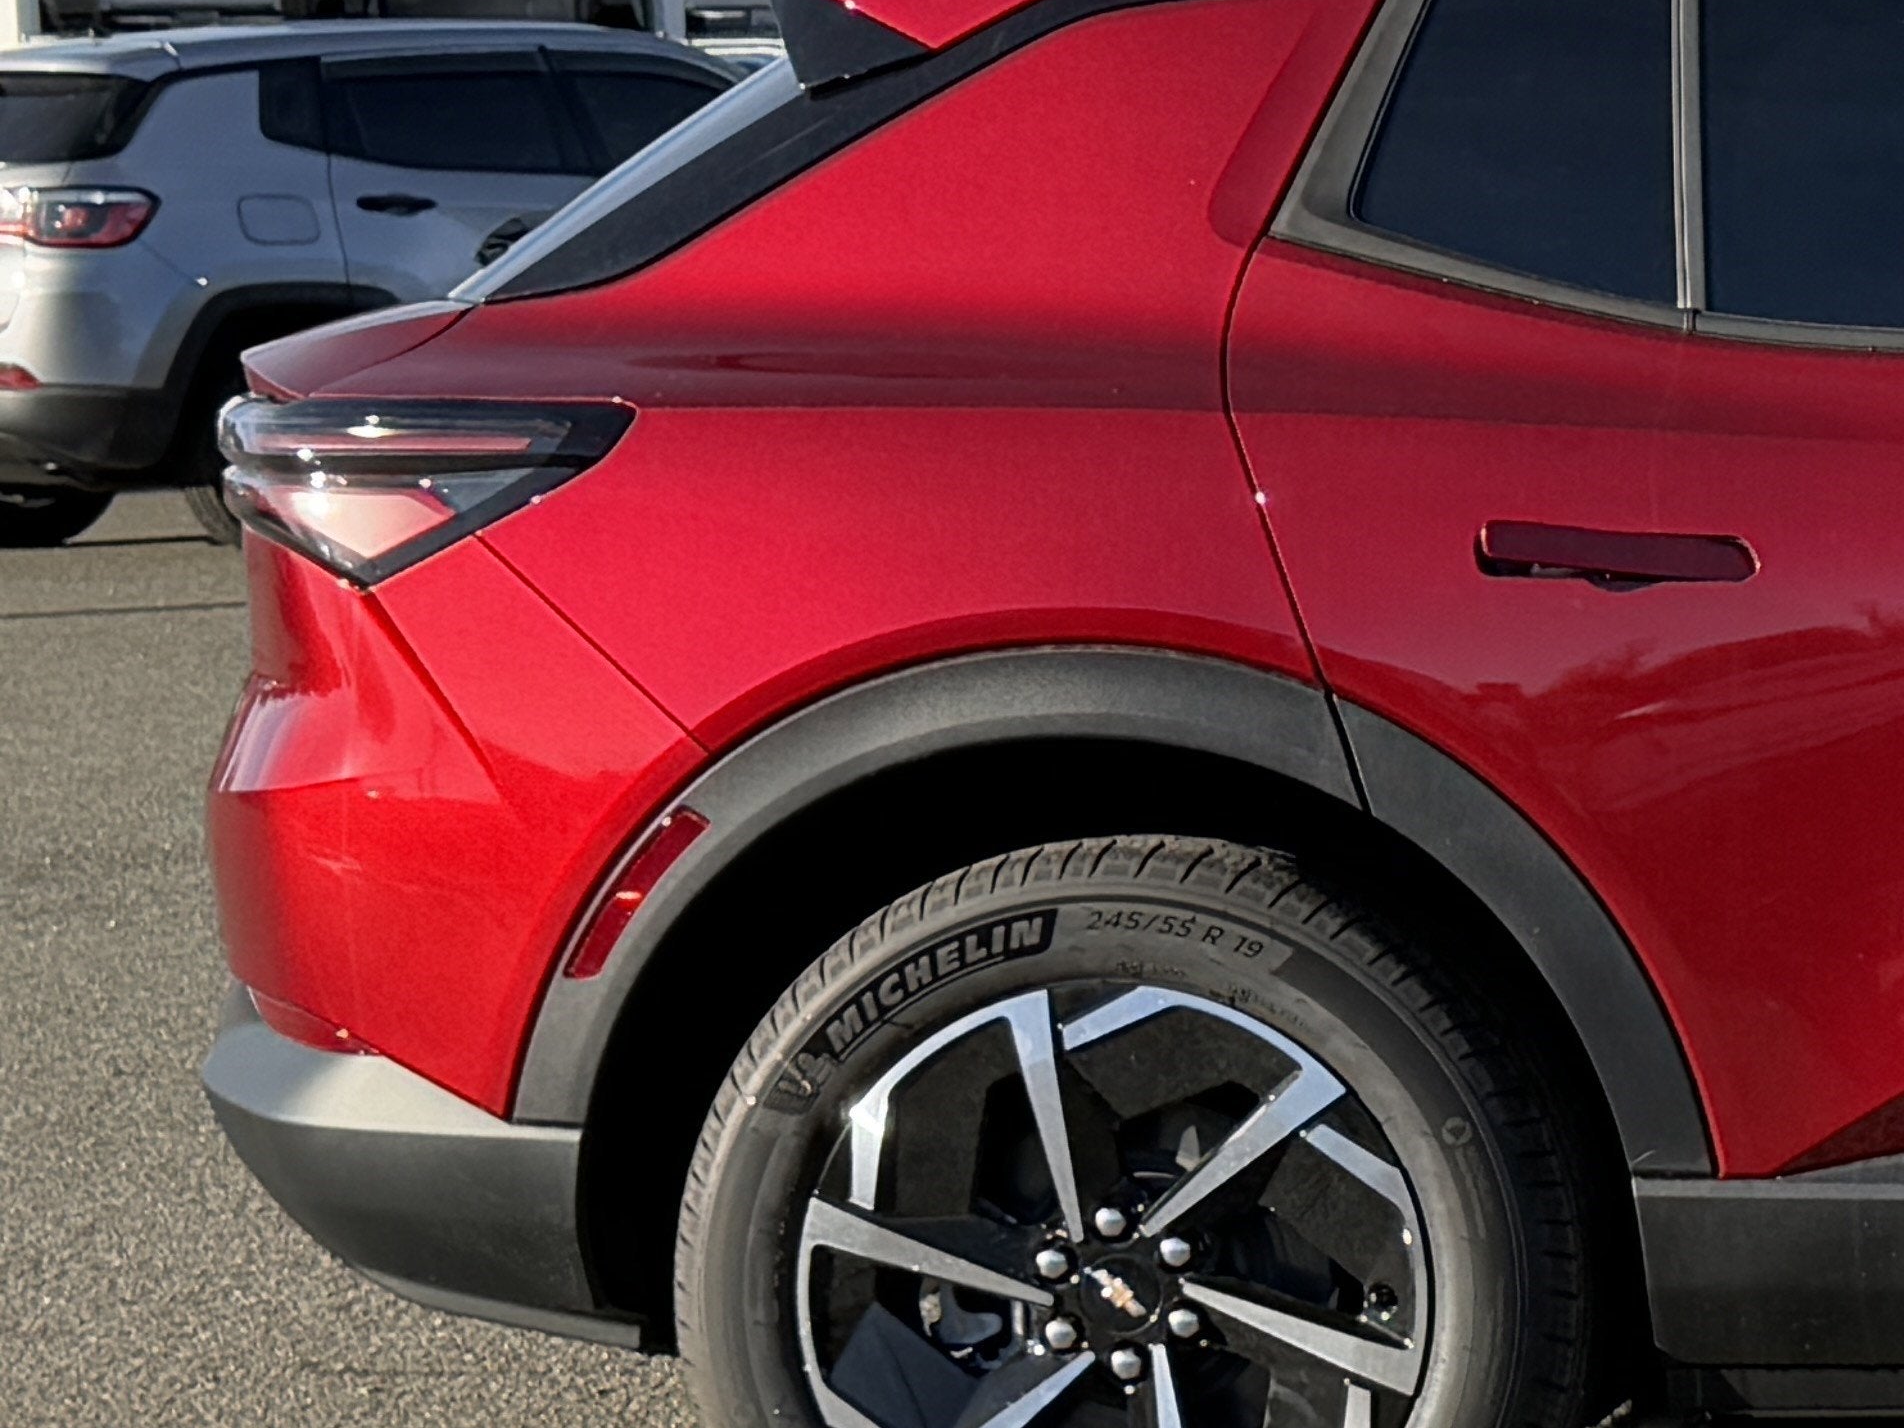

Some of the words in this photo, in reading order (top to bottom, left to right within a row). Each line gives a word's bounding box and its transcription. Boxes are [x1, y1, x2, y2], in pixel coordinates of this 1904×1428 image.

[1086, 910, 1197, 938] 245/55
[1201, 924, 1225, 945] R
[1233, 935, 1264, 958] 19
[825, 916, 1044, 1053] MICHELIN
